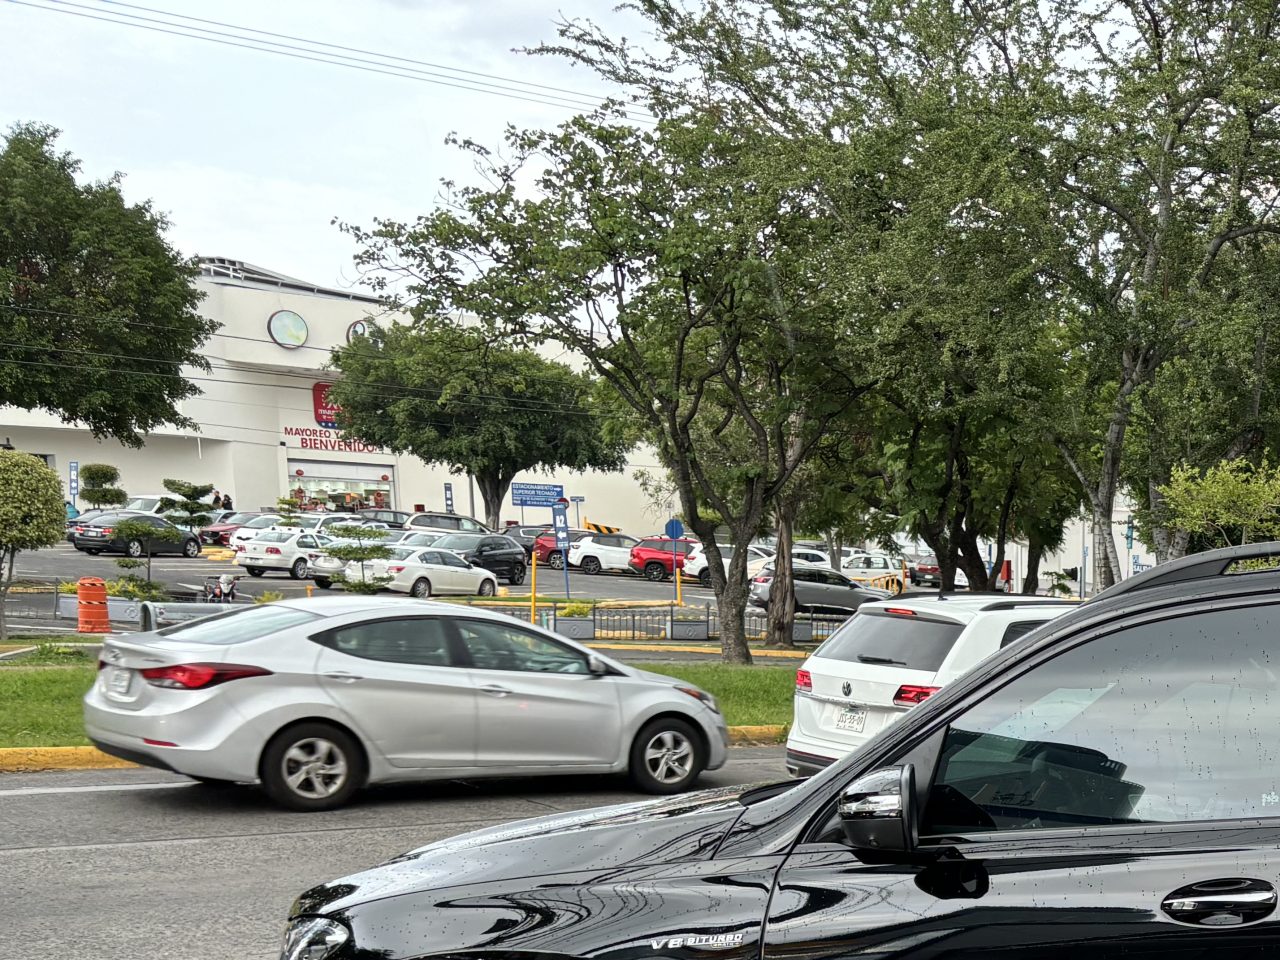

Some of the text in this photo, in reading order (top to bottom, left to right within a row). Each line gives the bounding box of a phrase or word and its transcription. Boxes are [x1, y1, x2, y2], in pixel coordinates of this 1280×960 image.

[284, 426, 340, 439] MAYOREO Y
[512, 483, 554, 491] ESTACIONAMIENTO
[650, 933, 743, 950] V8 BITURBO
